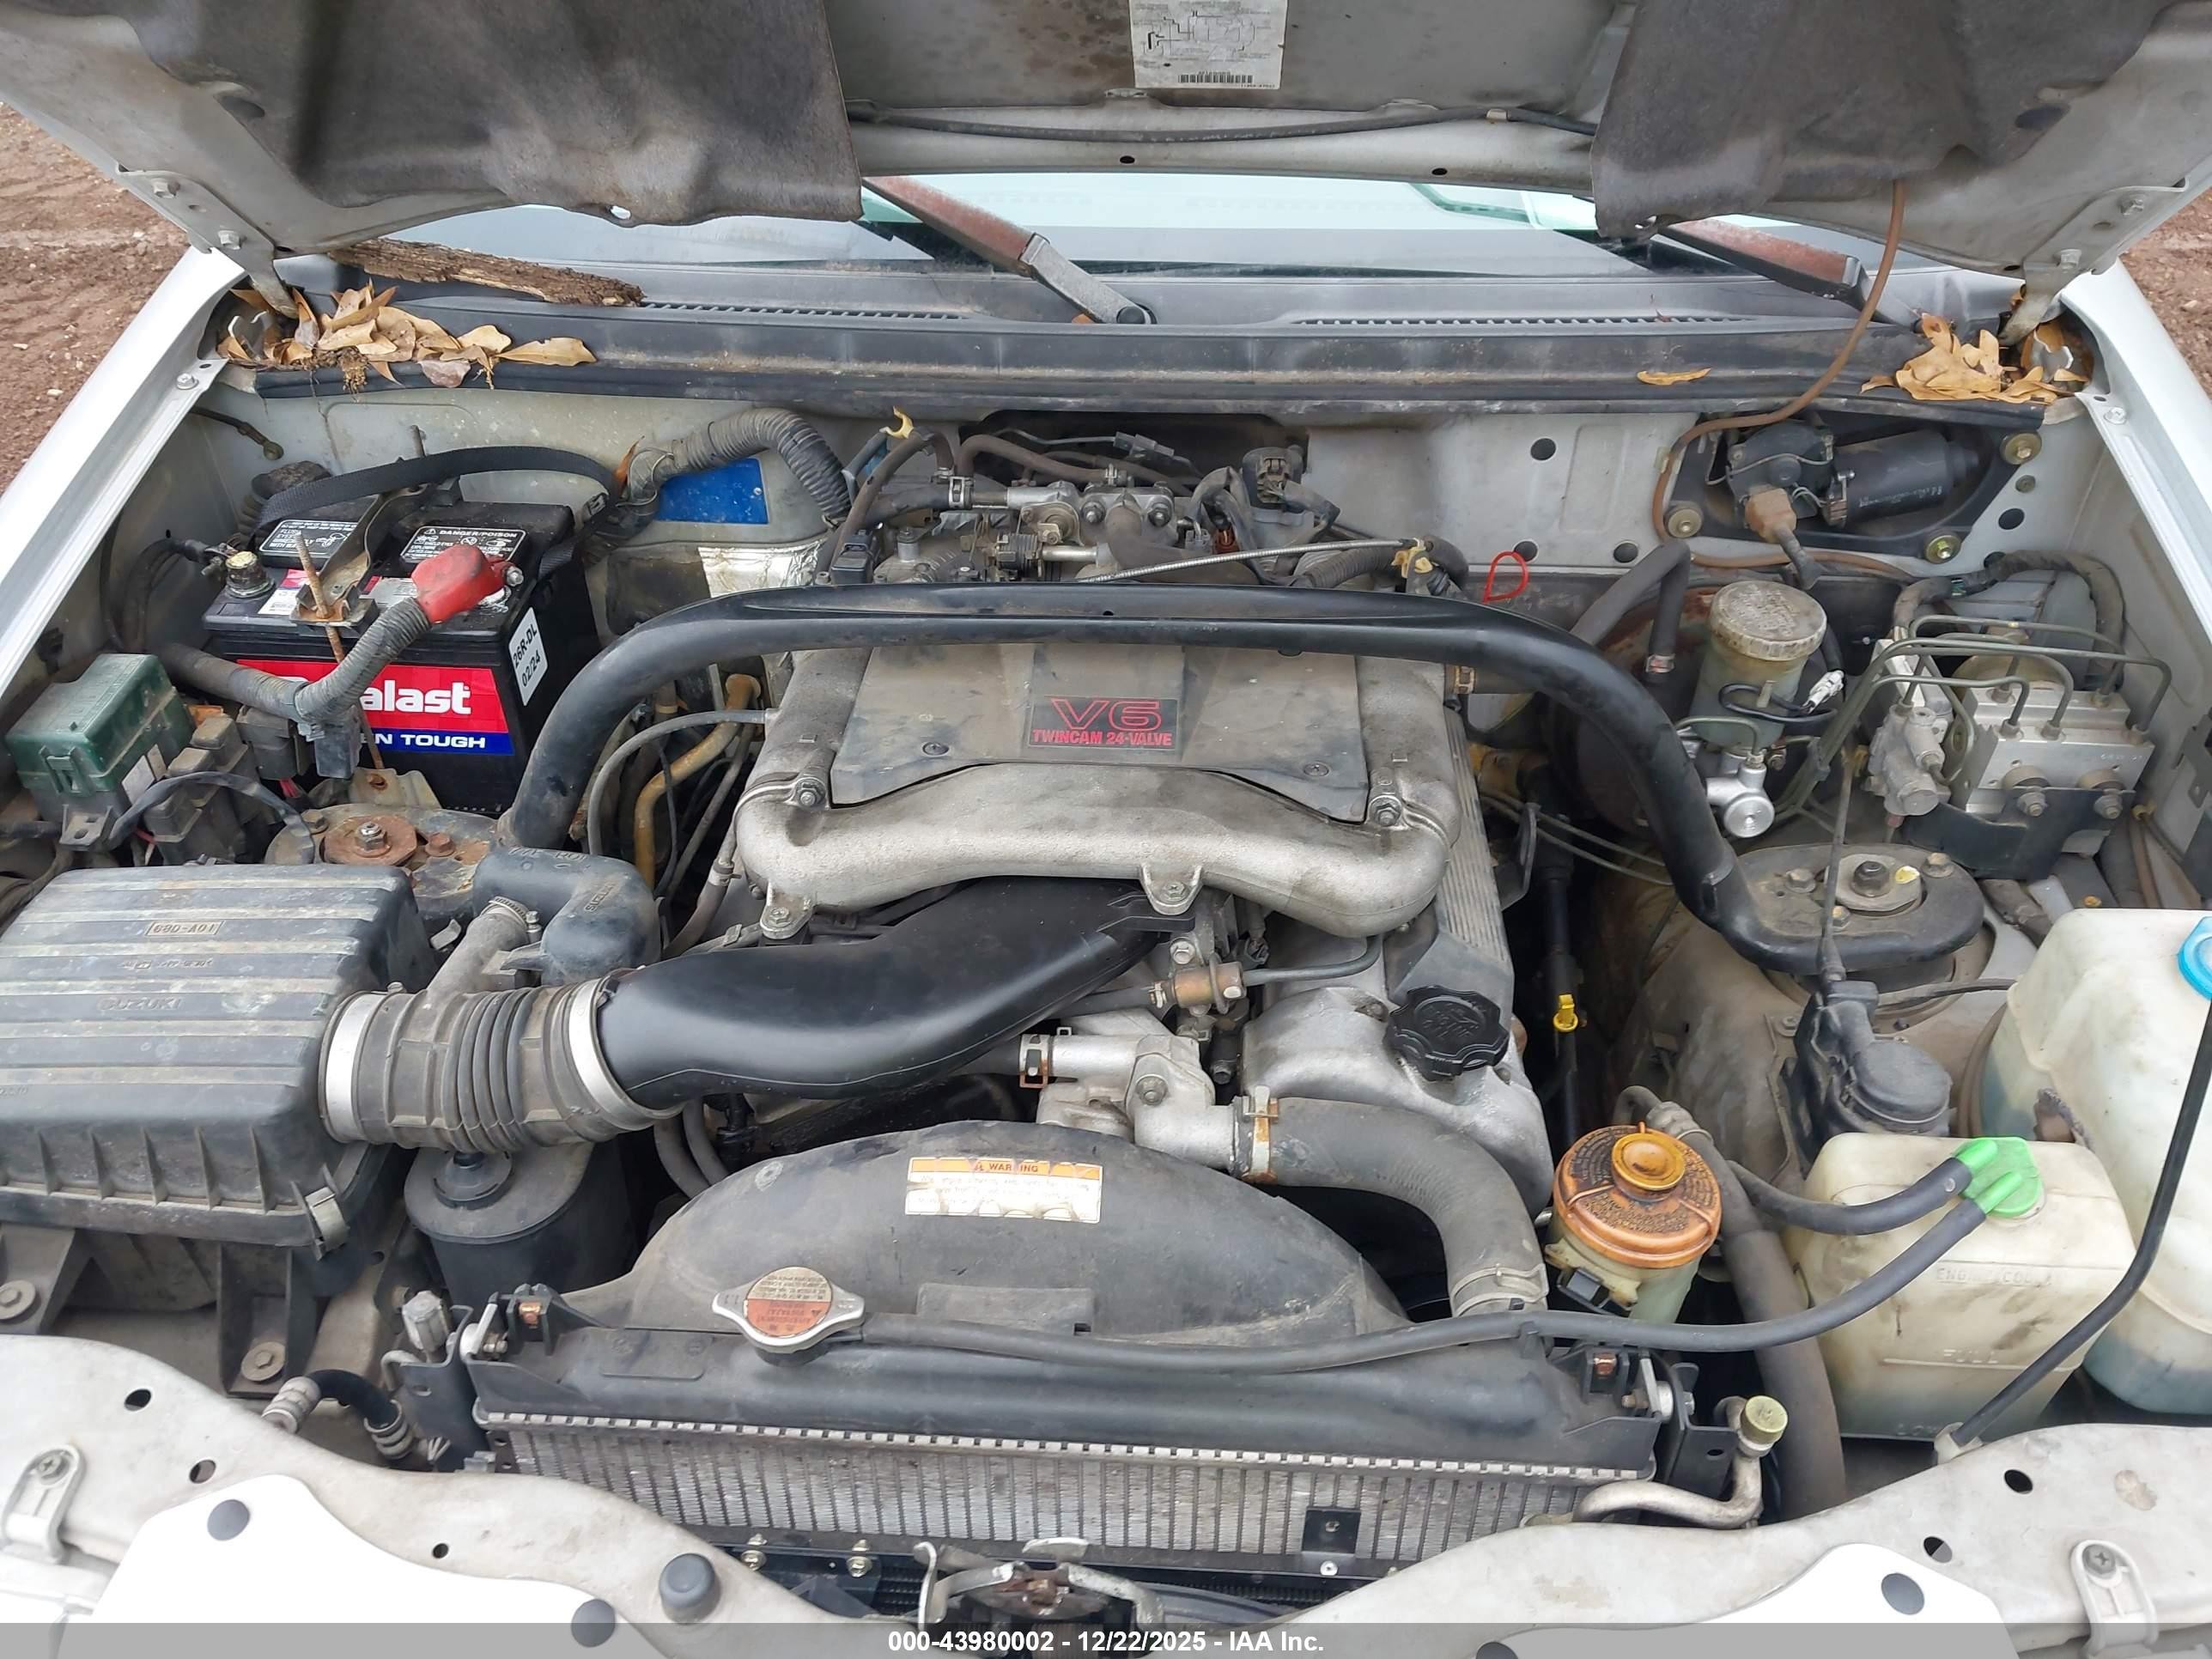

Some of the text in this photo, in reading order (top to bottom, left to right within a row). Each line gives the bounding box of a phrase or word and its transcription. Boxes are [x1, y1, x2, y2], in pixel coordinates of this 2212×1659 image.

[513, 623, 538, 669] 26R-DL
[521, 649, 541, 687] 02/24
[1050, 698, 1162, 731] V6
[400, 733, 486, 749] TOUGH
[1033, 730, 1172, 746] TWINCAM 24-VALVE
[989, 1161, 1039, 1173] WARING
